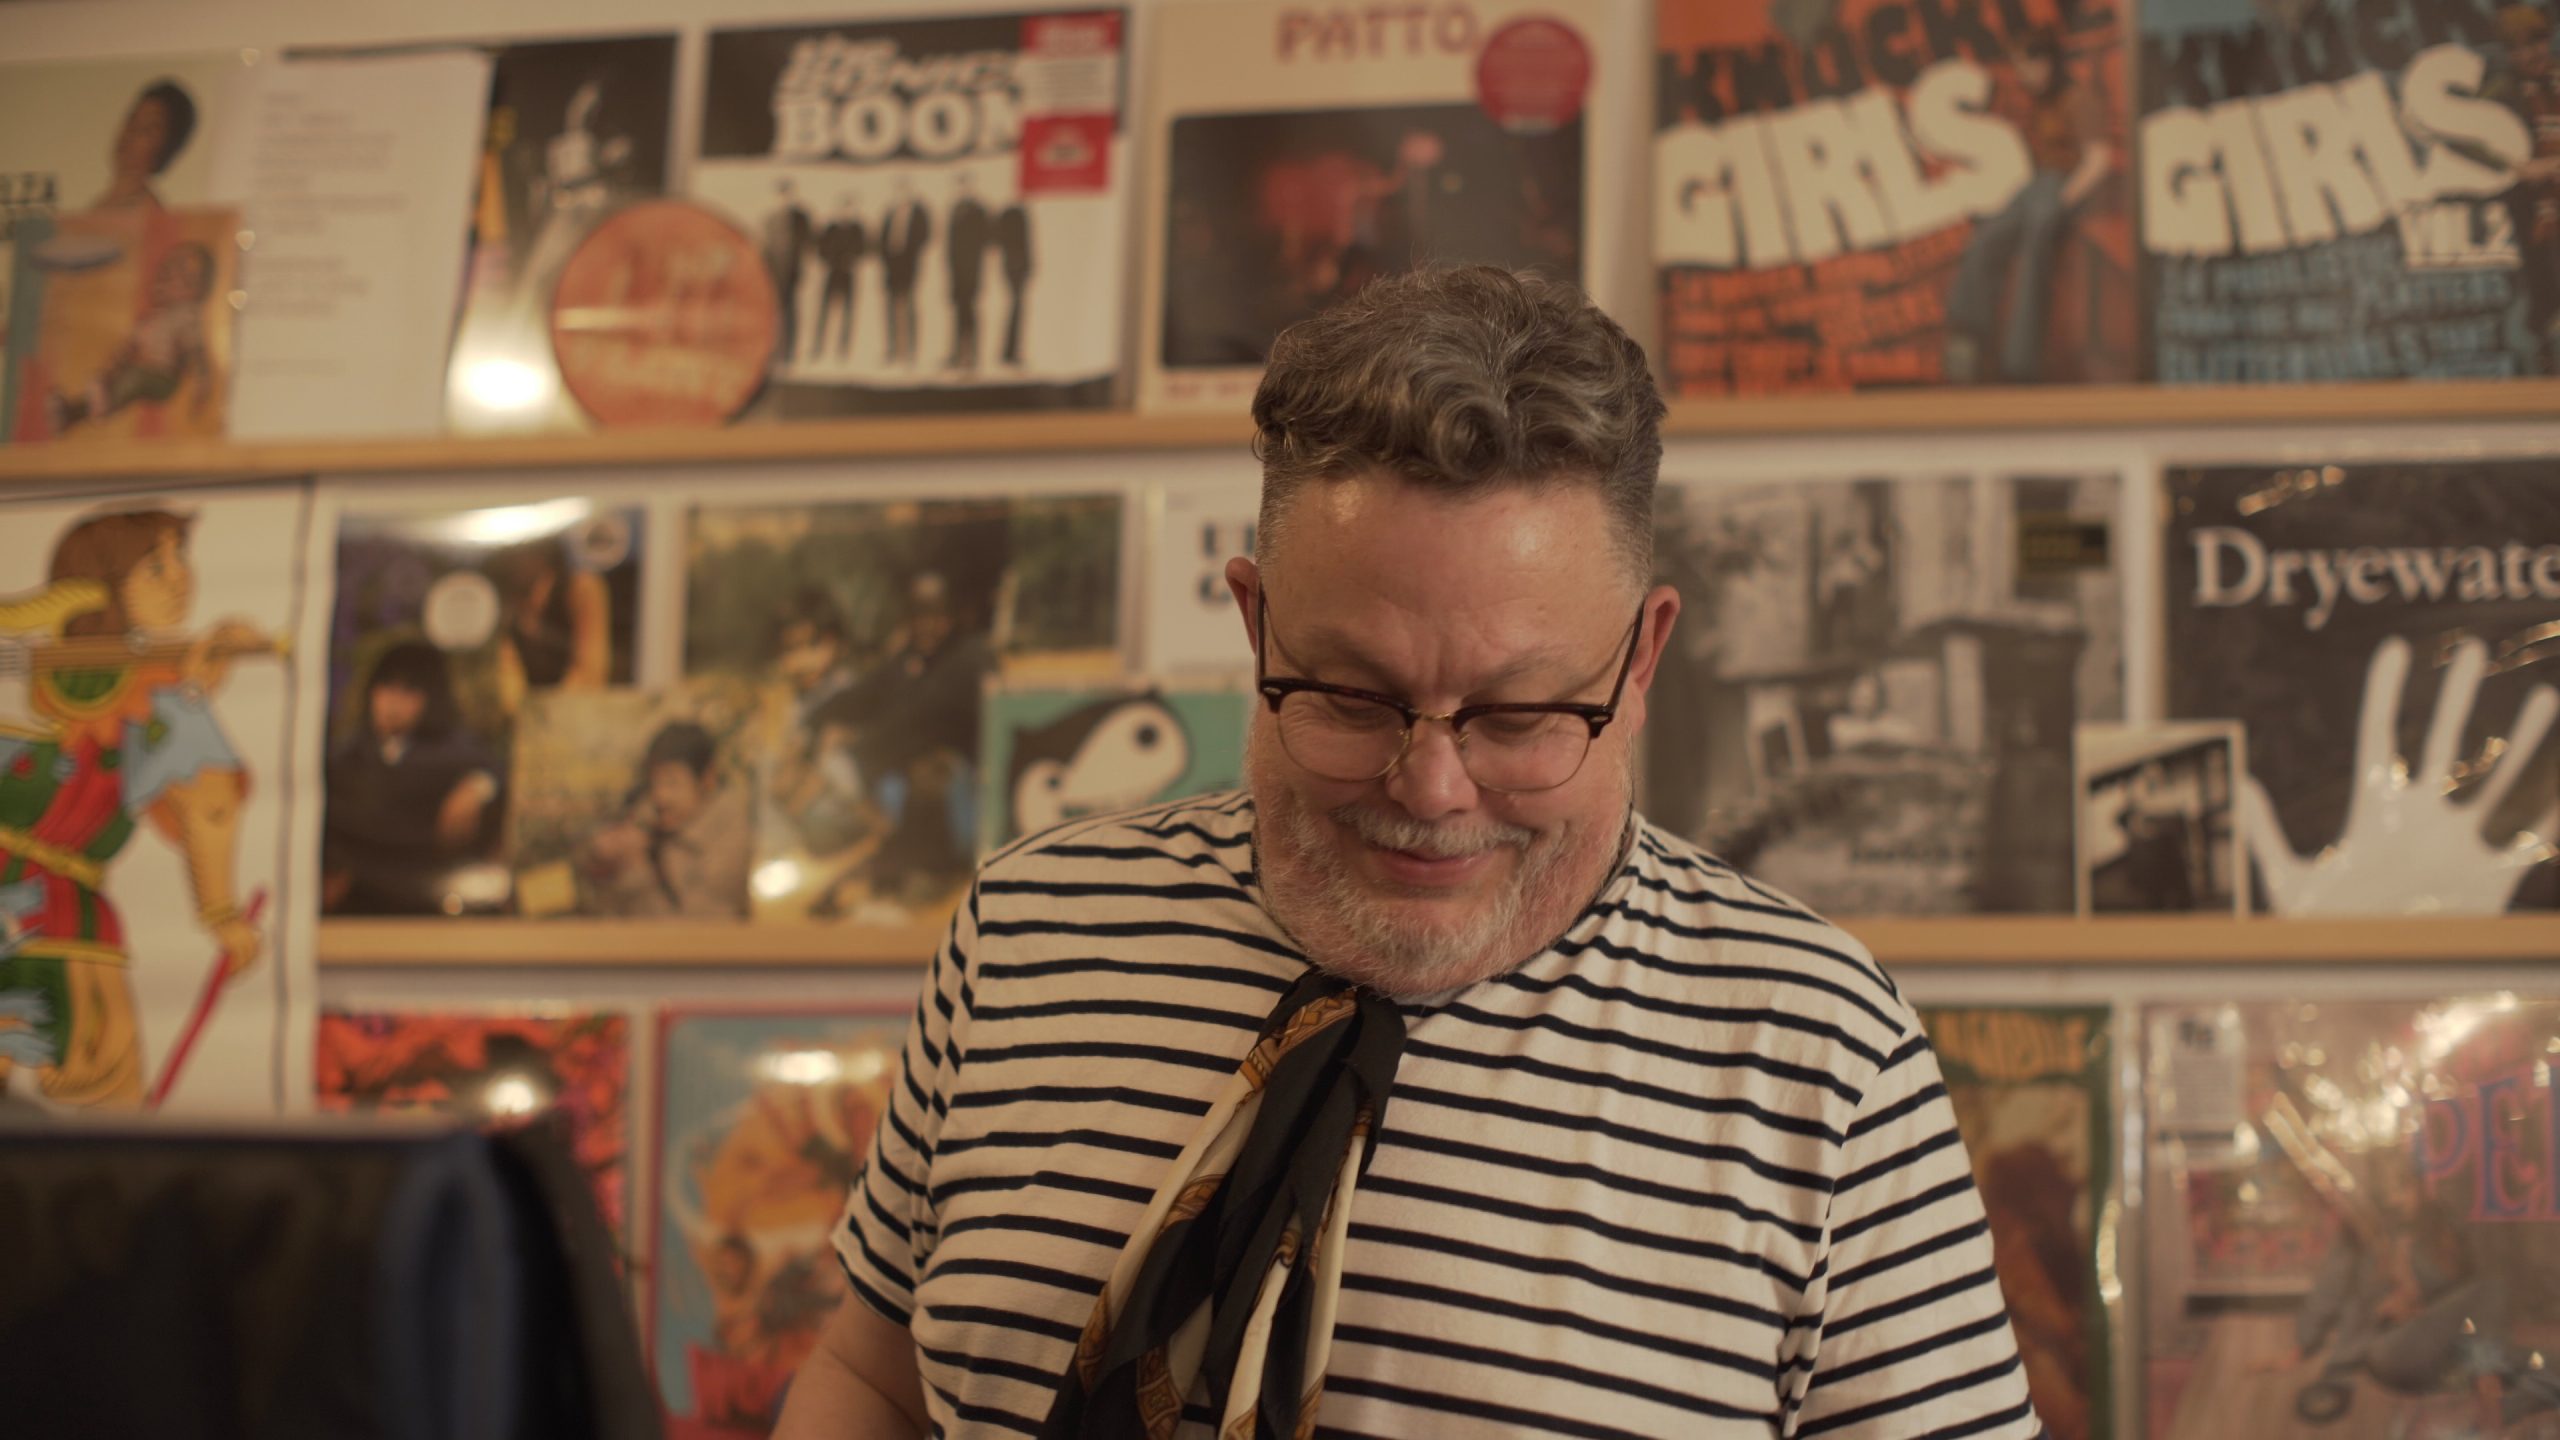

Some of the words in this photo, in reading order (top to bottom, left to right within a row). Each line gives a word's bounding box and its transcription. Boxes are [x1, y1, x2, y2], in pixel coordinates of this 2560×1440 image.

[1276, 4, 1478, 62] PATTO
[1653, 56, 2032, 269] GIRLS
[2142, 42, 2532, 257] GIRLS
